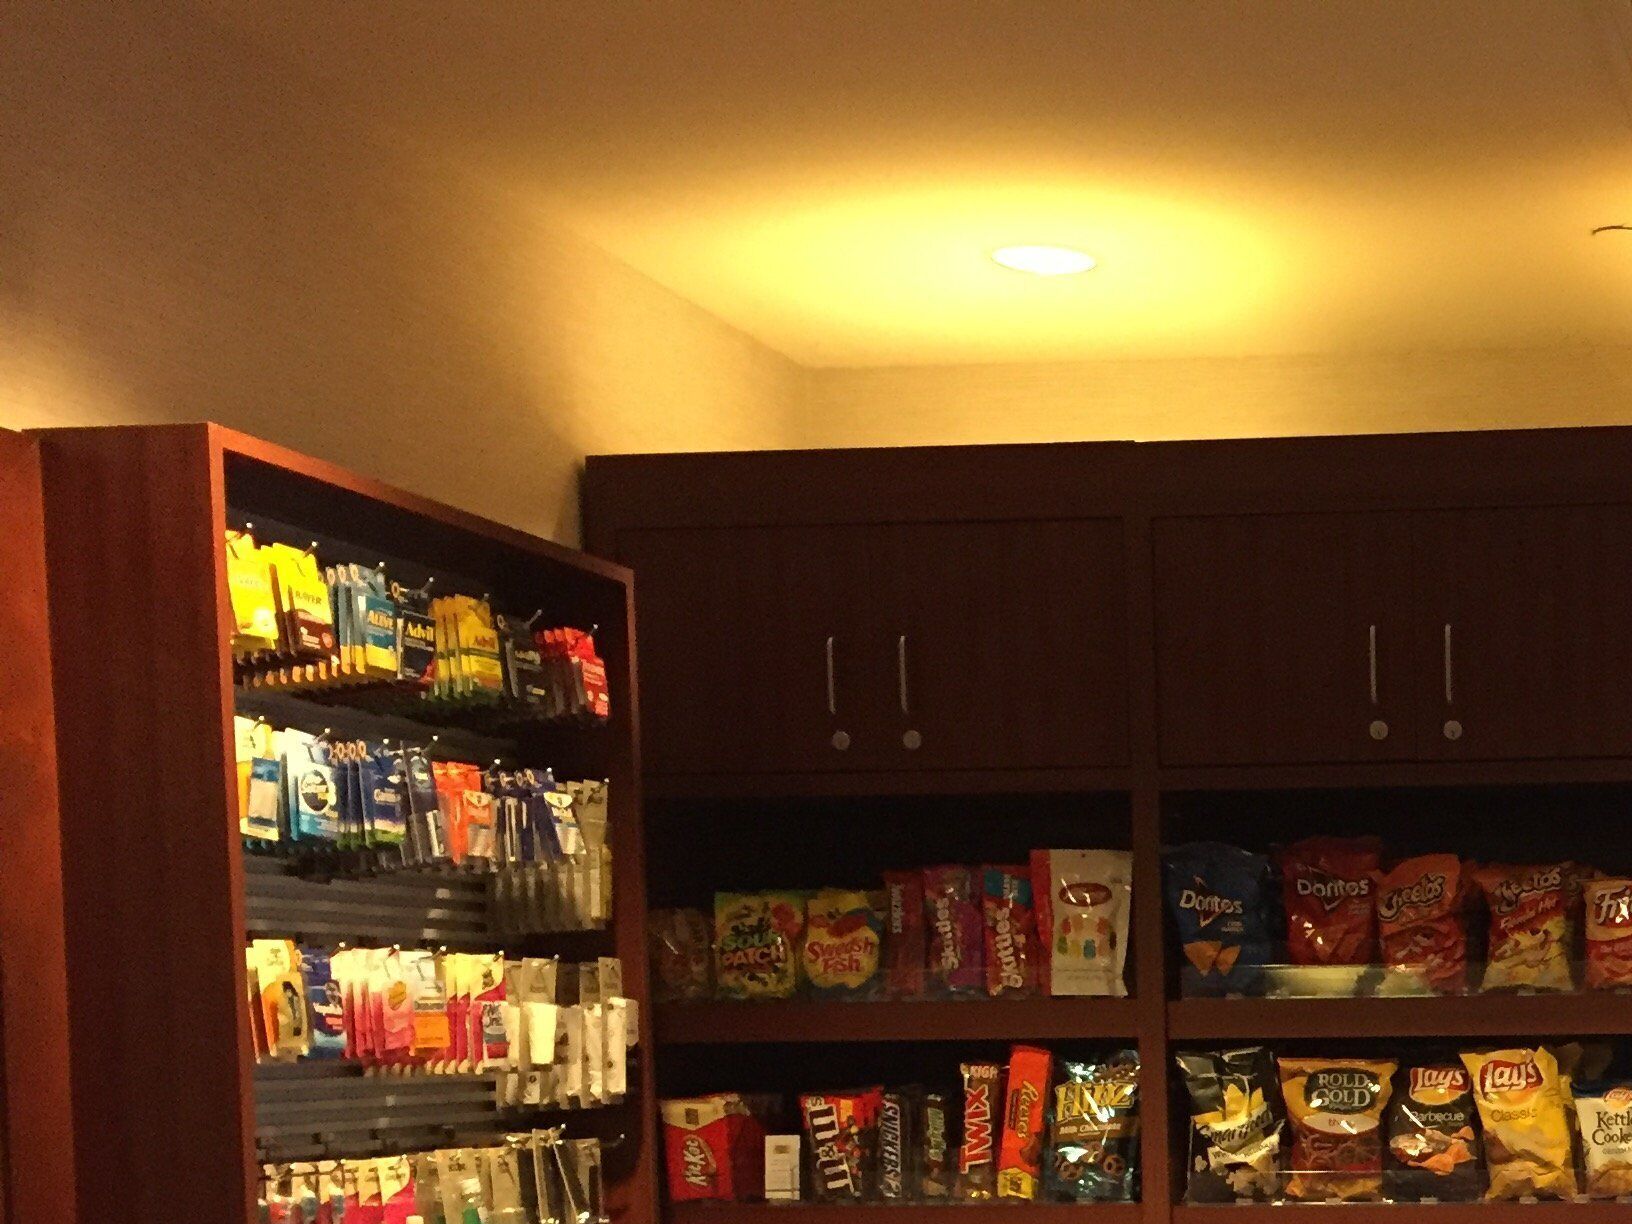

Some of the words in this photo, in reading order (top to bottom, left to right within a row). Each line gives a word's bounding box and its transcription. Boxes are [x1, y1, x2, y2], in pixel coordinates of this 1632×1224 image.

[406, 621, 434, 641] Advil
[1296, 878, 1370, 898] Doritos
[1179, 888, 1243, 915] Doritos
[1319, 1072, 1369, 1088] ROLD
[1412, 1067, 1466, 1091] Lay's
[1484, 1058, 1539, 1096] Lay's
[1311, 1088, 1371, 1108] GOLD
[1410, 1109, 1466, 1123] Barbecue
[960, 1083, 993, 1176] TWIX
